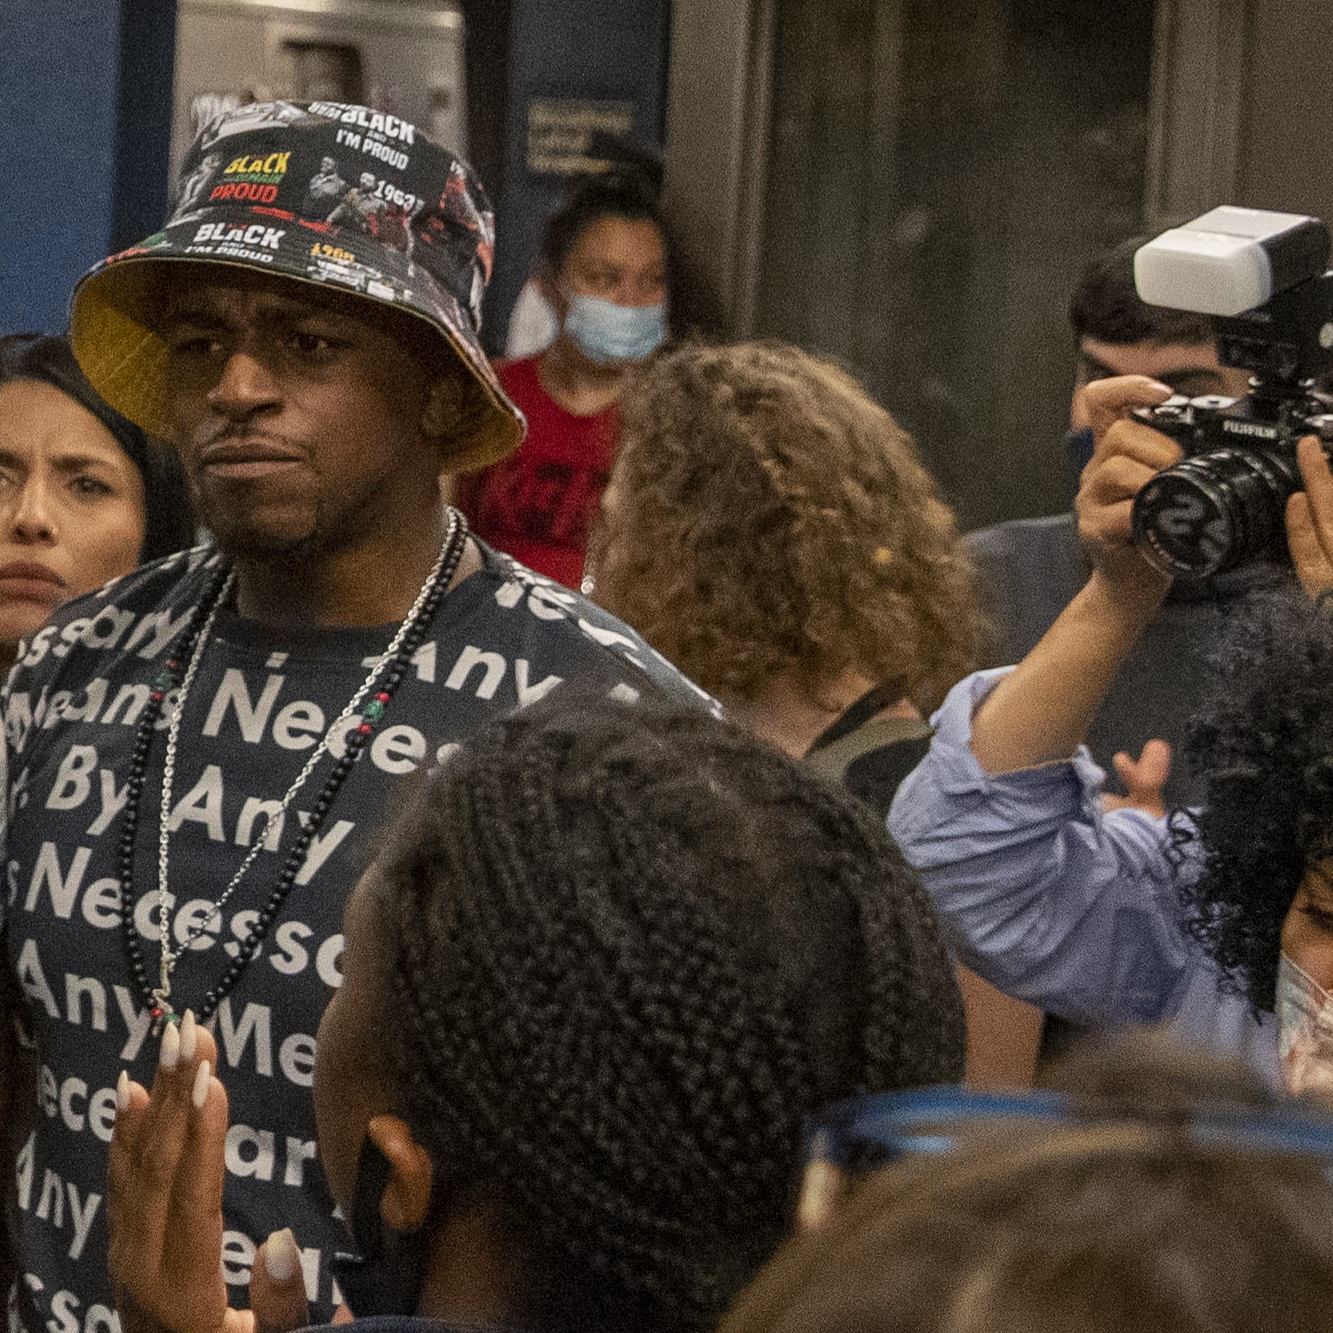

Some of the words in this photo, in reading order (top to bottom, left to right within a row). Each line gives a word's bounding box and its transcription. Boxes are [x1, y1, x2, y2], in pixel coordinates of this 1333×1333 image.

[209, 182, 279, 203] PROUD
[336, 128, 362, 150] I'M
[362, 137, 410, 171] PROUD
[45, 744, 131, 836] By
[167, 764, 355, 887] Any
[15, 938, 153, 1061] Any
[16, 1130, 102, 1261] Any
